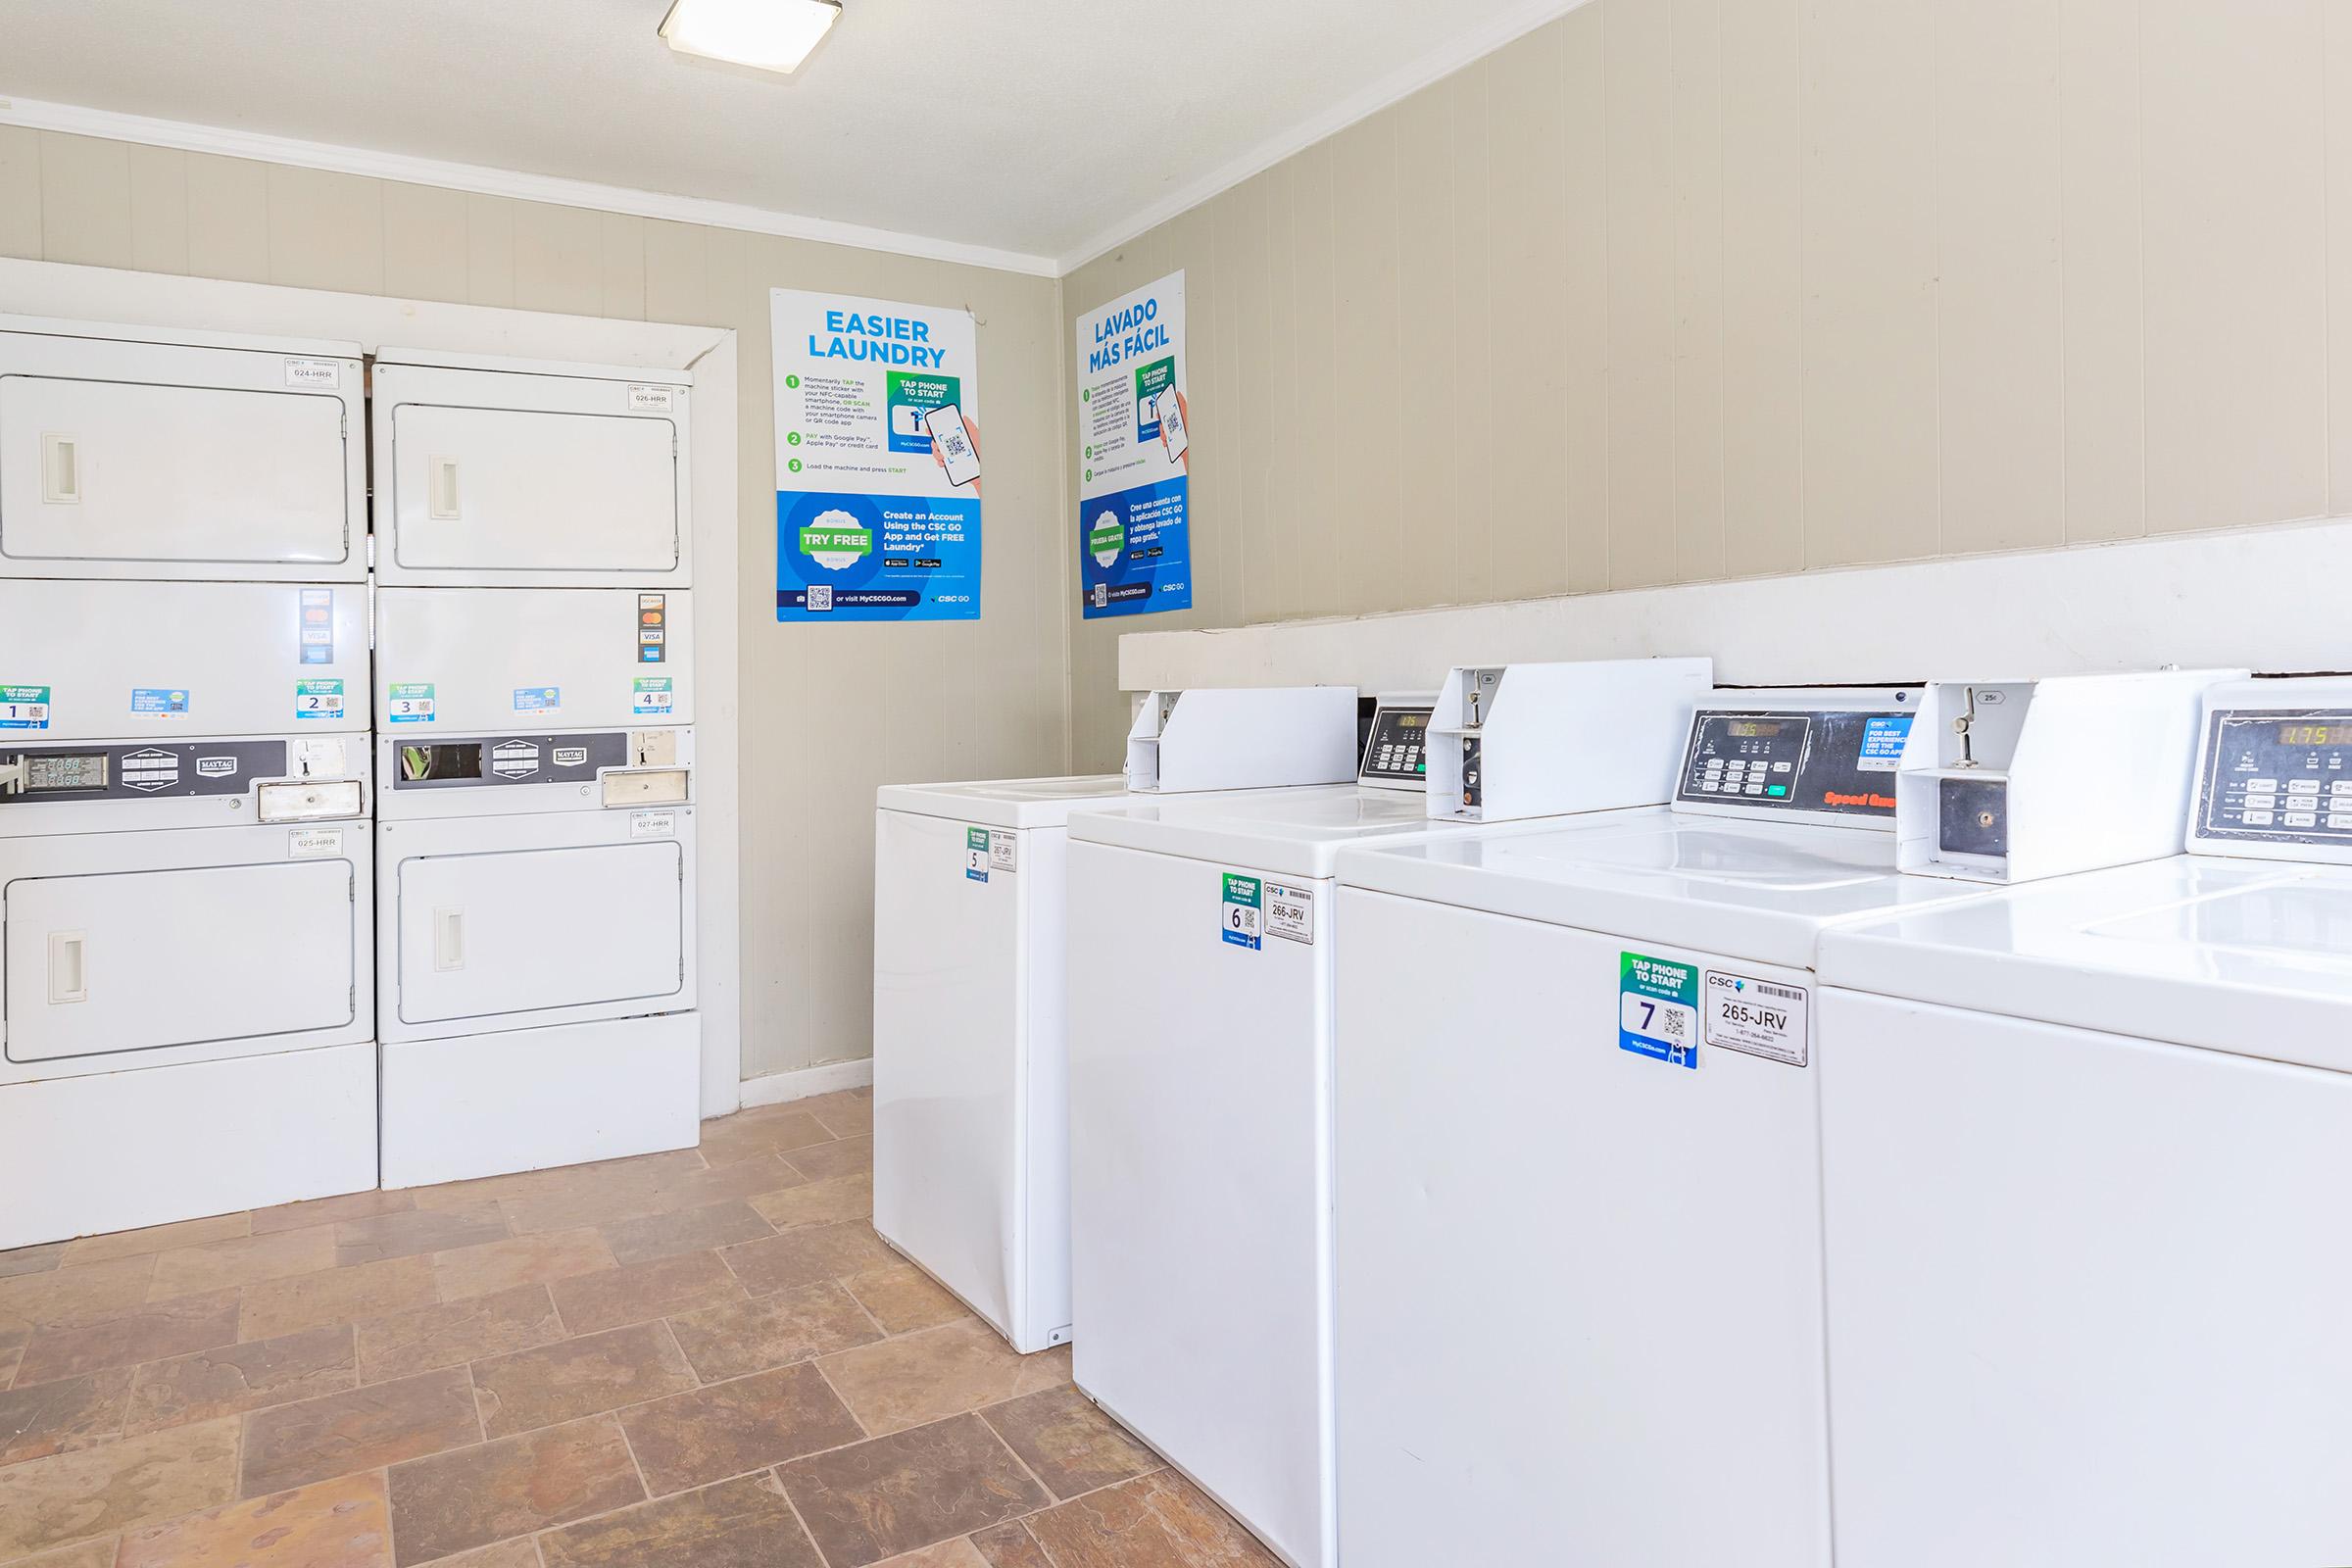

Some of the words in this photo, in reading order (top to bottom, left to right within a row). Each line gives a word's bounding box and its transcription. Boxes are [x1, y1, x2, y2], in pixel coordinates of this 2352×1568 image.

[826, 310, 929, 343] EASIER
[1096, 298, 1157, 343] LAVADO
[809, 335, 947, 368] LAUNDRY
[1090, 341, 1120, 373] MÁS
[1125, 323, 1169, 360] FÁCIL
[294, 369, 332, 378] 024-HRR
[1152, 366, 1167, 376] PHONE
[789, 376, 796, 386] 1
[804, 376, 841, 385] Momentarily
[1152, 373, 1166, 385] START
[918, 382, 948, 391] PHONE
[792, 462, 799, 470] 3
[1152, 498, 1170, 507] cuenta
[928, 513, 964, 521] Account
[1136, 510, 1161, 522] aplicación
[1162, 507, 1173, 515] CSC
[884, 521, 909, 531] Using
[804, 534, 830, 545] TRY
[833, 535, 868, 545] FREE
[884, 532, 903, 541] App
[310, 698, 318, 709] 2
[644, 694, 652, 705] 4
[10, 706, 17, 717] 1
[402, 702, 411, 712] 3
[2288, 727, 2328, 744] 1.75
[1824, 791, 1869, 807] Speed
[972, 853, 977, 867] 5
[1228, 878, 1238, 887] TAP
[1239, 880, 1255, 890] PHONE
[1238, 887, 1253, 897] START
[1232, 908, 1241, 928] 6
[1273, 905, 1304, 921] 266-JRV
[1632, 959, 1650, 970] TAP
[1652, 963, 1688, 980] PHONE
[1636, 970, 1649, 981] TO
[1651, 974, 1683, 989] START
[1709, 976, 1734, 988] CSC
[1640, 1002, 1655, 1030] 7
[1722, 1004, 1787, 1030] 265-JRV
